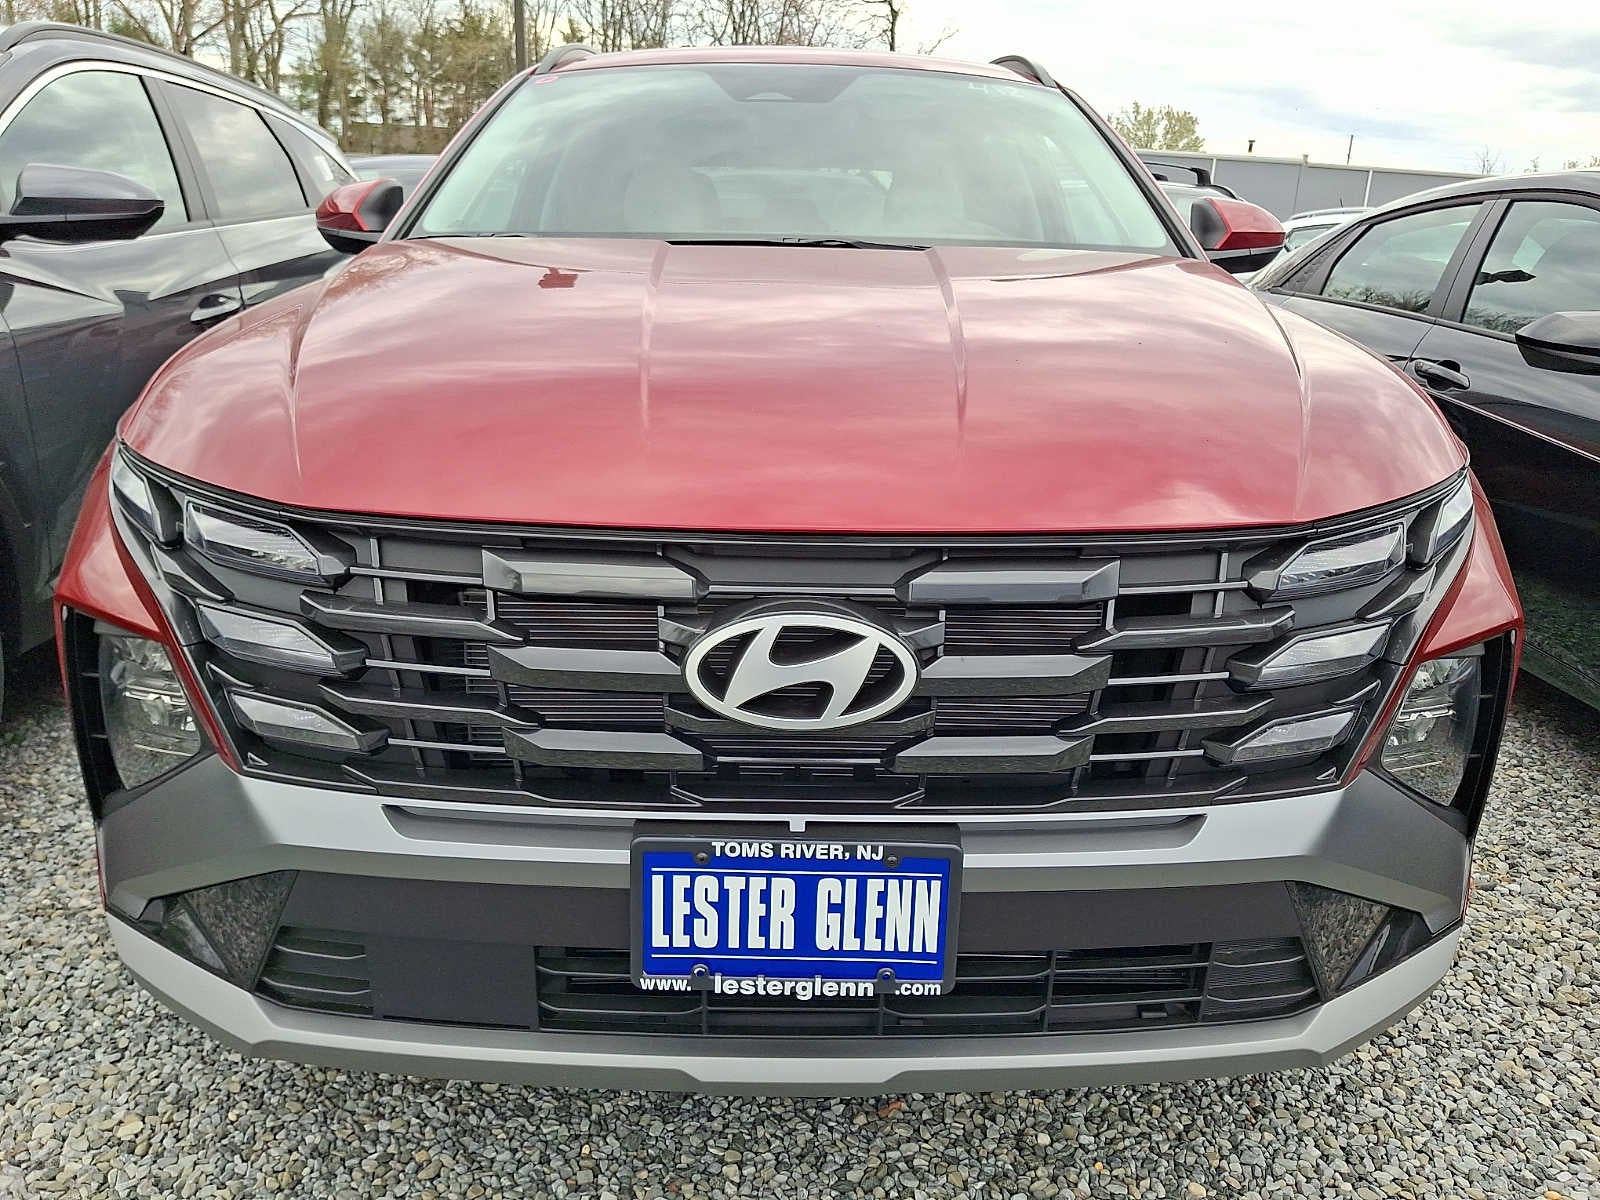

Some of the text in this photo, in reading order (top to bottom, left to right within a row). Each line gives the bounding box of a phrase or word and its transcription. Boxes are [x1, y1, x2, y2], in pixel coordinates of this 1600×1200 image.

[711, 841, 884, 861] TOMS RIVER, NJ
[651, 874, 942, 954] LESTER GLENN
[639, 977, 692, 991] www.
[714, 973, 874, 1000] lesterglenn
